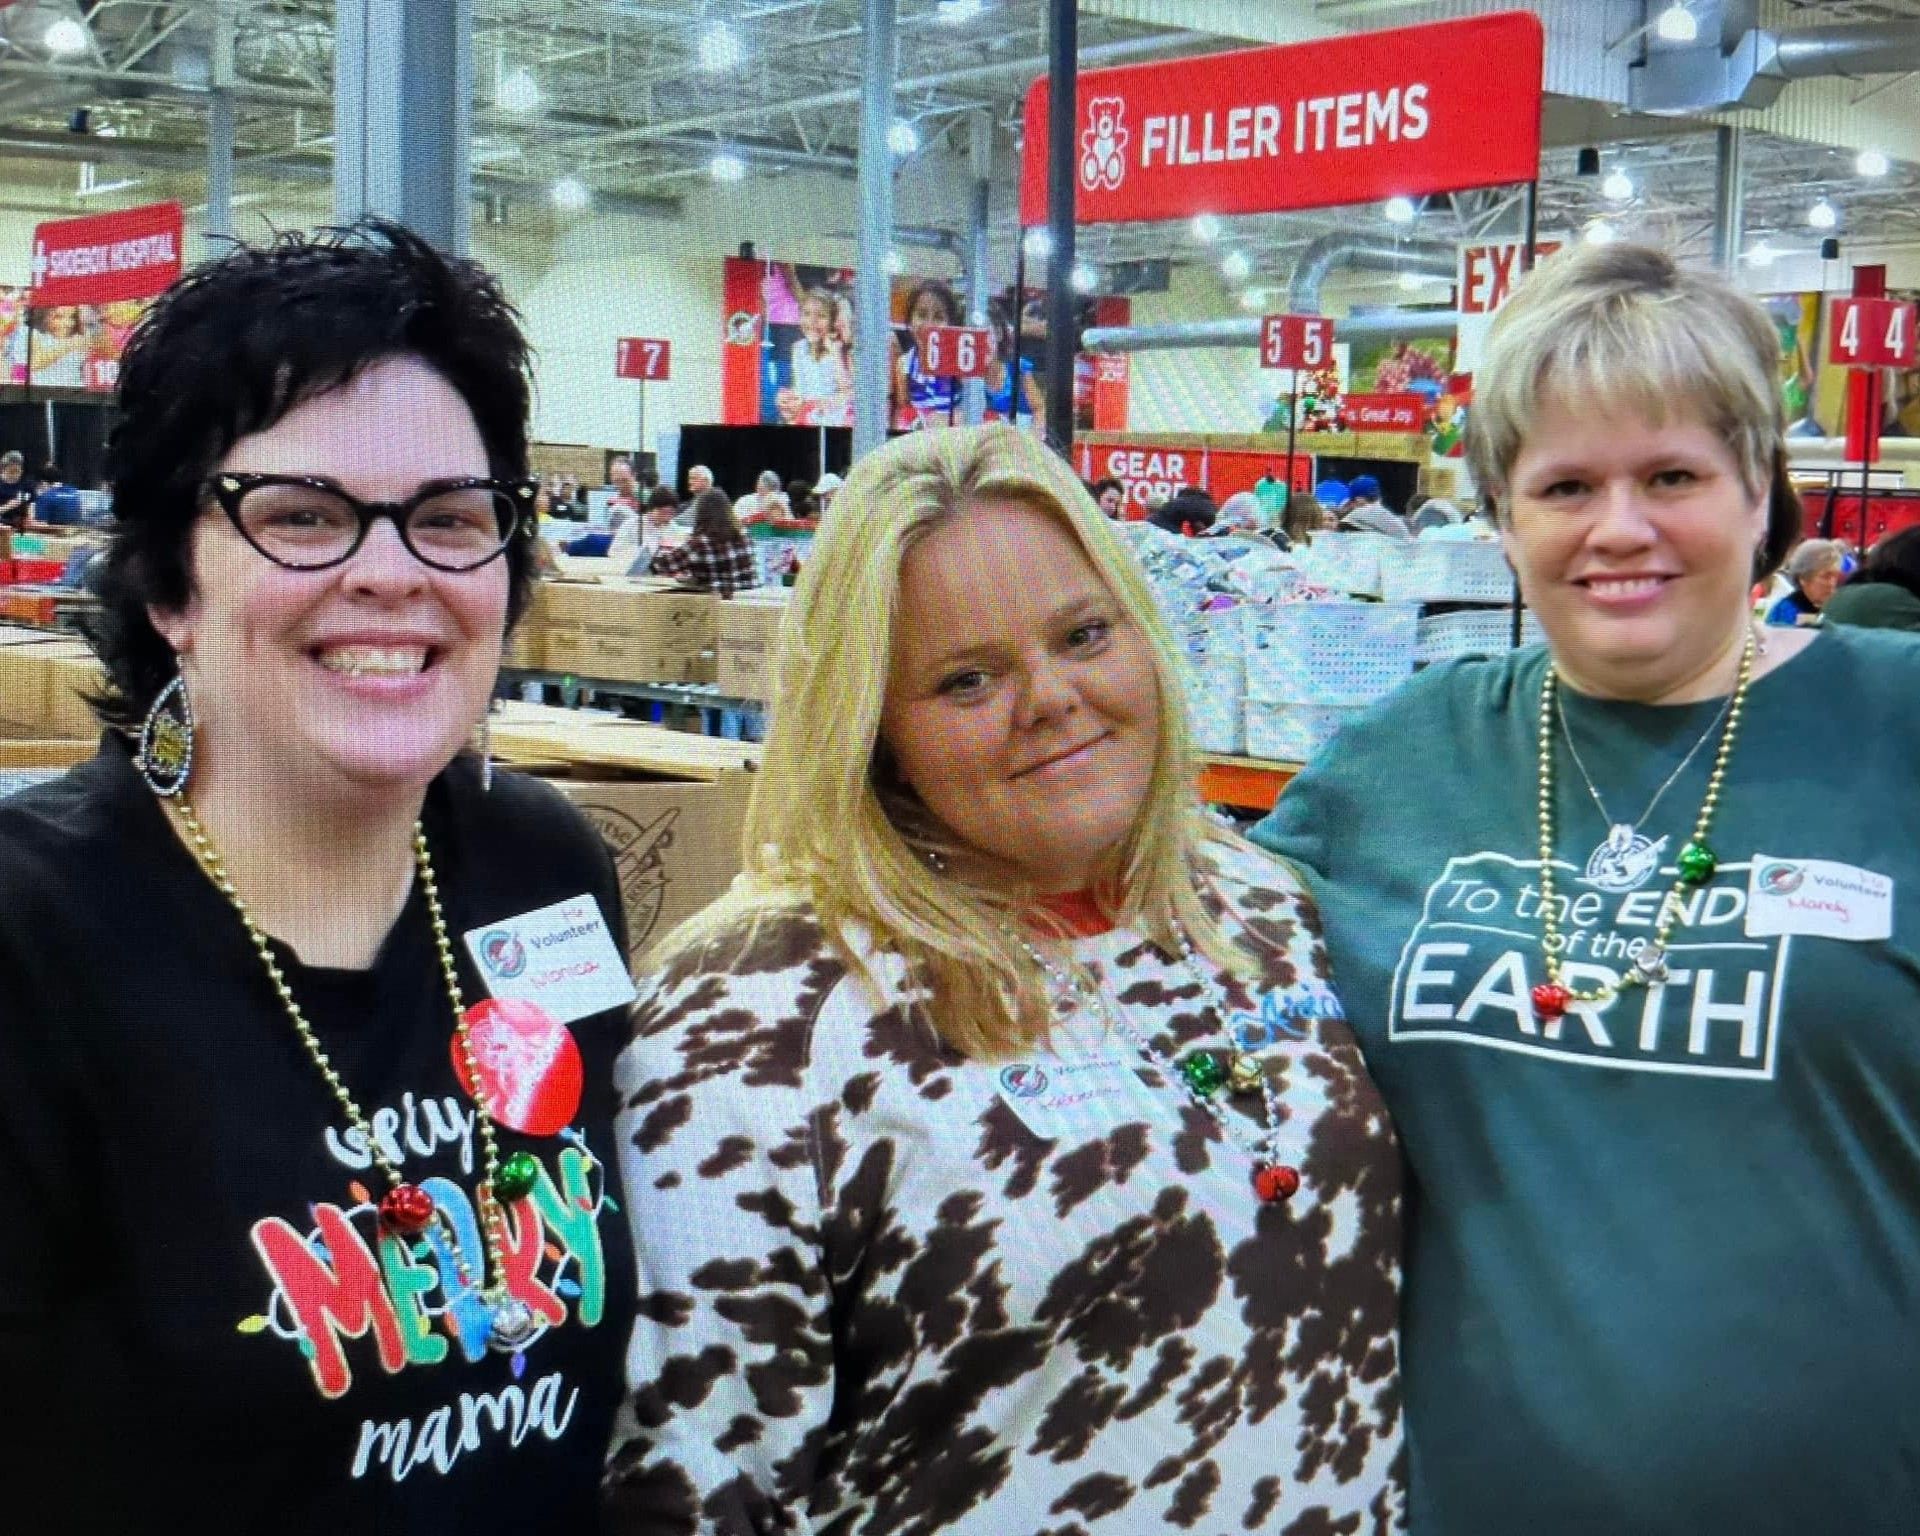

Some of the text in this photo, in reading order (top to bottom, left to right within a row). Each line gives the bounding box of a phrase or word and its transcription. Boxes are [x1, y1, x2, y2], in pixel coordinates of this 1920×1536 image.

[1140, 83, 1430, 168] FILLER ITEMS
[49, 232, 176, 277] SHOEBOX HOSPITAL
[928, 331, 940, 371] 6
[958, 333, 976, 373] 6
[1267, 320, 1322, 366] 5 5
[1840, 304, 1904, 359] 4 4
[643, 342, 662, 375] 7
[1107, 451, 1185, 479] GEAR
[1446, 880, 1747, 927] To the END
[1813, 873, 1888, 899] Volunteer
[530, 920, 600, 949] Volunteer
[1542, 929, 1647, 960] of the
[1402, 942, 1766, 1058] EARTH
[251, 1147, 605, 1399] MERRY
[351, 1371, 580, 1481] mama
